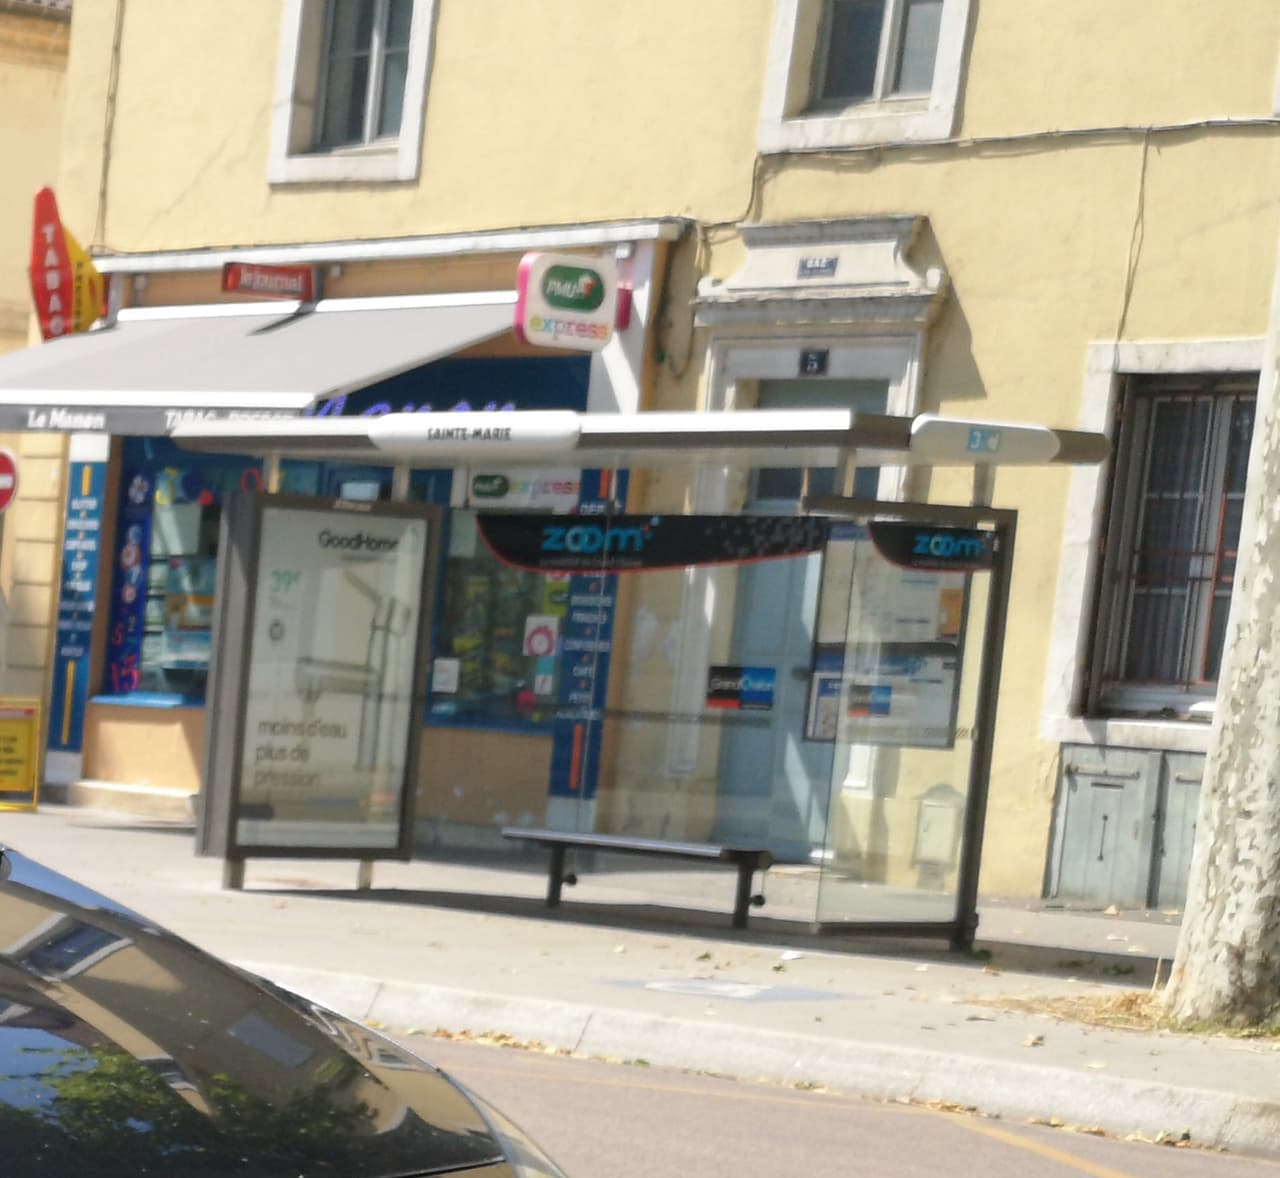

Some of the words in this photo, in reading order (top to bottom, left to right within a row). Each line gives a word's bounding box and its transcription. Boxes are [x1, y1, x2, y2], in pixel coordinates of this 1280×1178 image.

[546, 279, 578, 297] PMU
[530, 317, 609, 340] express
[427, 427, 512, 442] SAINTE-MARIE
[542, 525, 643, 552] zoom
[912, 535, 982, 556] zoom
[258, 720, 304, 736] moins
[255, 743, 288, 764] plus
[290, 744, 311, 762] de
